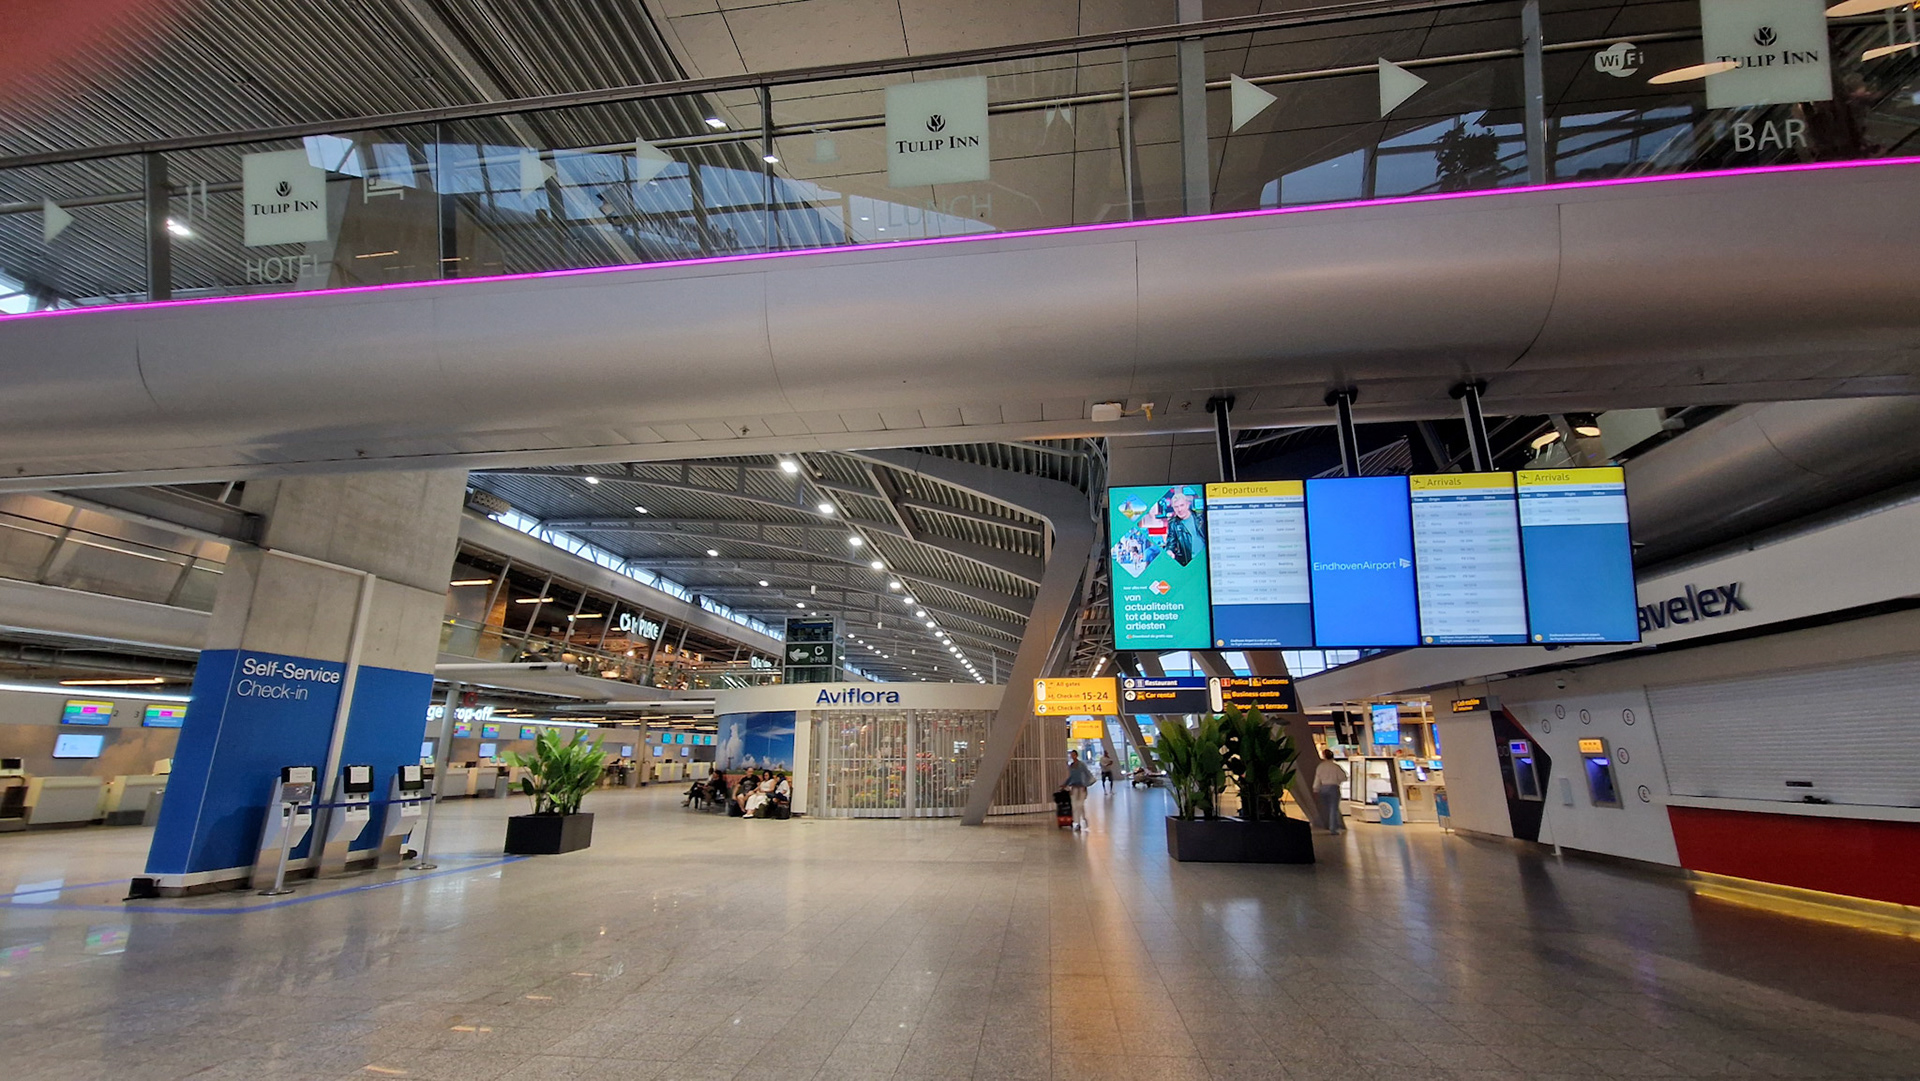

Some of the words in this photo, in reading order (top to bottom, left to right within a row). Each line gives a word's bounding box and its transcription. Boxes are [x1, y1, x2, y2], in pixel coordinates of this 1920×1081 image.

[1717, 54, 1775, 69] TULIP
[1783, 50, 1819, 65] INN
[1733, 118, 1807, 153] BAR
[895, 139, 943, 154] TULIP
[949, 135, 979, 148] INN
[251, 203, 290, 215] TULIP
[294, 200, 318, 212] INN
[888, 193, 992, 227] LUNCH
[246, 254, 327, 283] HOTEL
[1427, 478, 1461, 486] Arrivals
[1534, 473, 1570, 482] Arrivals
[1222, 486, 1268, 495] Departures
[1313, 561, 1396, 571] EindhovenAirport
[1124, 603, 1184, 611] actualiteiten
[1638, 582, 1745, 632] avelex
[1125, 613, 1139, 621] tot
[1140, 612, 1152, 621] de
[1153, 611, 1178, 620] beste
[1125, 621, 1166, 631] artiesten
[242, 658, 340, 683] Self-Service
[237, 679, 308, 701] Check-in
[816, 687, 899, 704] Aviflora
[1082, 692, 1108, 700] 15-24
[1083, 704, 1102, 712] 1-14
